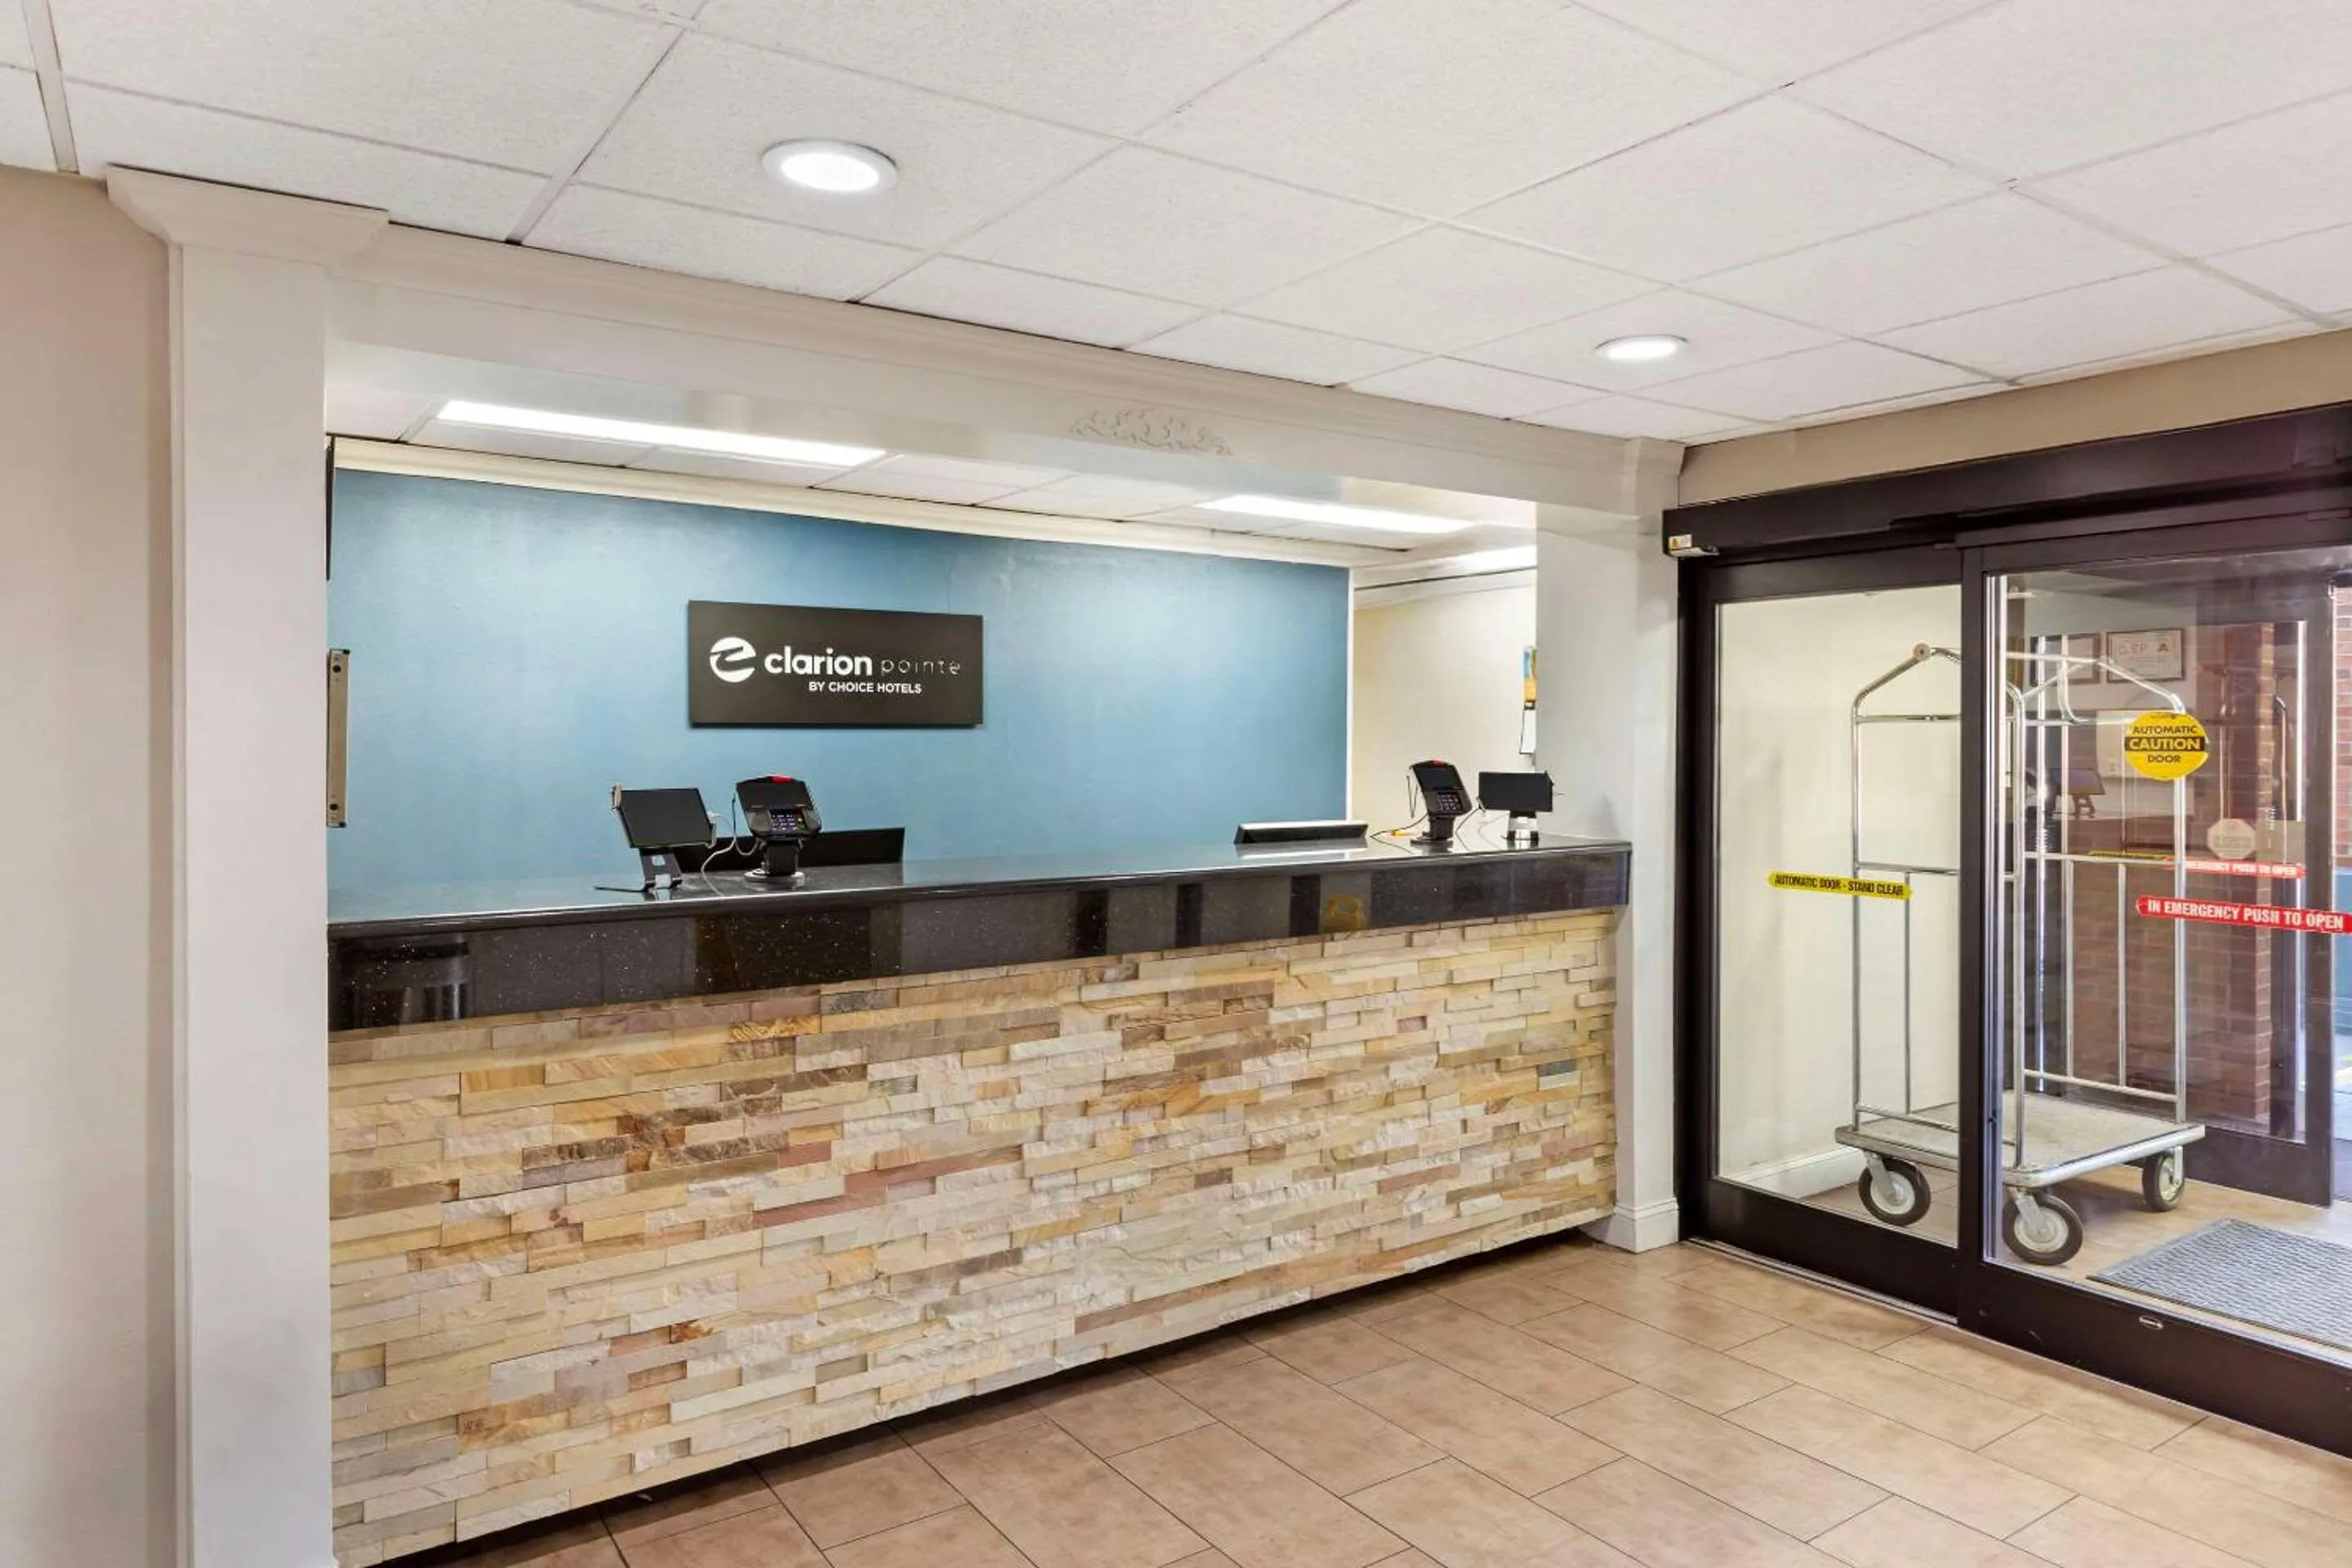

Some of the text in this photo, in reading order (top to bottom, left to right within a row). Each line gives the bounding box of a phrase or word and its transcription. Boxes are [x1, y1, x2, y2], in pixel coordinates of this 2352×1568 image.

[764, 646, 960, 676] clarion pointe
[808, 681, 922, 694] BY CHOICE HOTELS
[2132, 726, 2196, 734] AUTOMATIC
[2128, 737, 2201, 751] CAUTION
[2147, 755, 2181, 763] DOOR
[1775, 874, 1817, 888] AUTOMATIC
[1848, 880, 1874, 893] STAND
[2148, 900, 2344, 929] IN EMERGENCY PUSH TO OPEN
